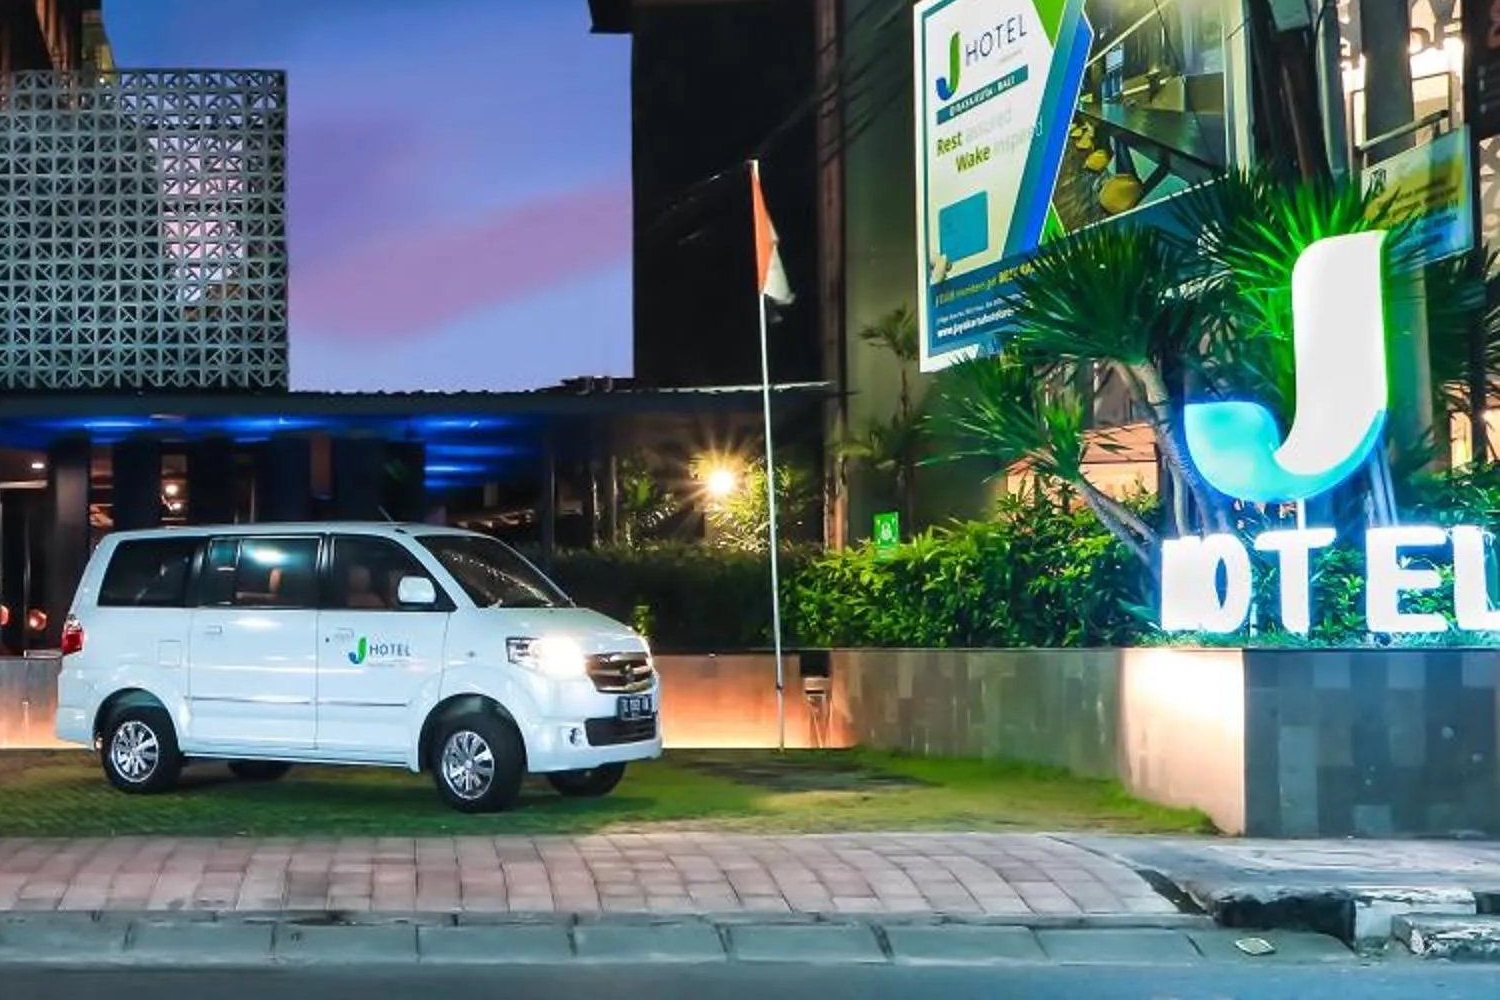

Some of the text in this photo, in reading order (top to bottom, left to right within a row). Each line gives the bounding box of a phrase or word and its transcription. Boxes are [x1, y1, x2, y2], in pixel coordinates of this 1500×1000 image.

[965, 14, 1028, 67] HOTEL
[936, 132, 963, 157] Rest
[955, 146, 992, 173] Wake
[369, 643, 412, 657] HOTEL
